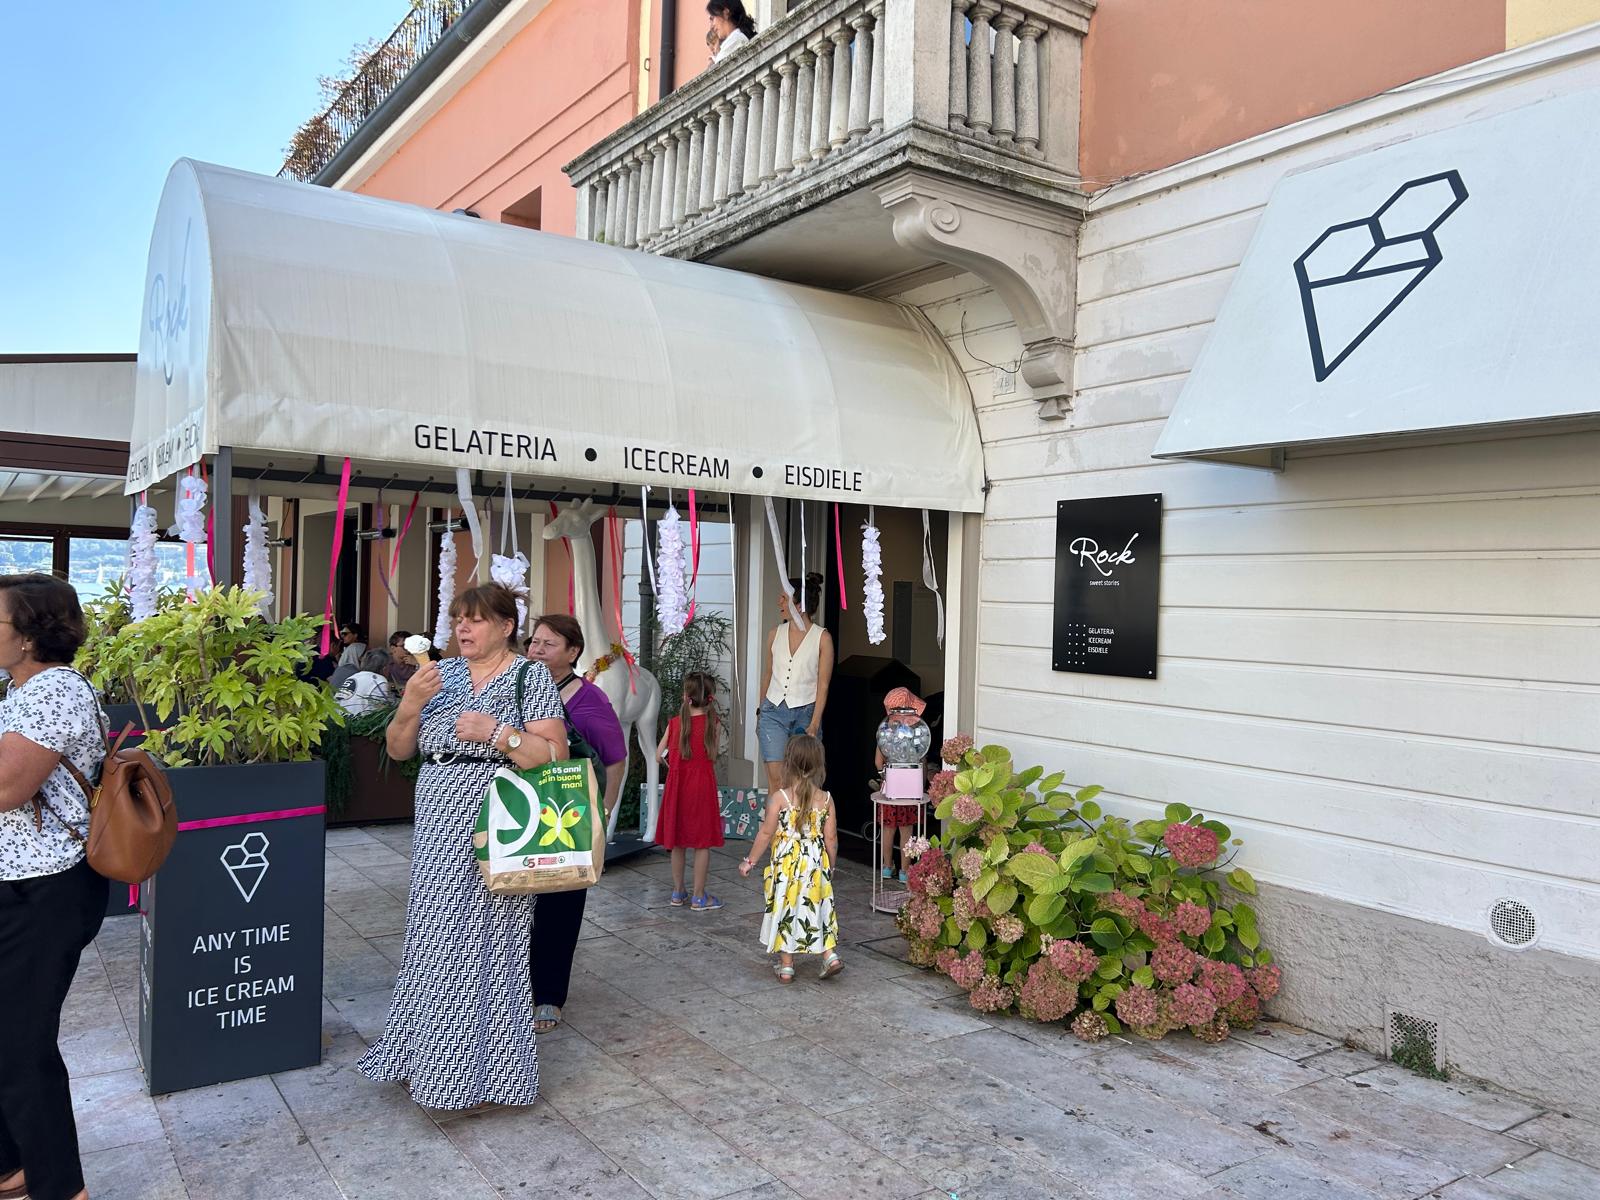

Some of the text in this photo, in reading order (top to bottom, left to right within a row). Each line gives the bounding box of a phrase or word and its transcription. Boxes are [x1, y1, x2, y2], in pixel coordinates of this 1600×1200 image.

[414, 424, 863, 492] GELATERIA ICECREAM EISDIELE
[1069, 533, 1139, 576] Rock
[548, 774, 556, 782] in
[552, 766, 562, 774] 65
[563, 765, 582, 773] anni
[561, 781, 583, 789] mani
[523, 857, 535, 868] 65
[192, 924, 290, 954] ANY TIME
[234, 955, 252, 974] IS
[188, 975, 294, 1008] ICE CREAM
[216, 1005, 267, 1029] TIME
